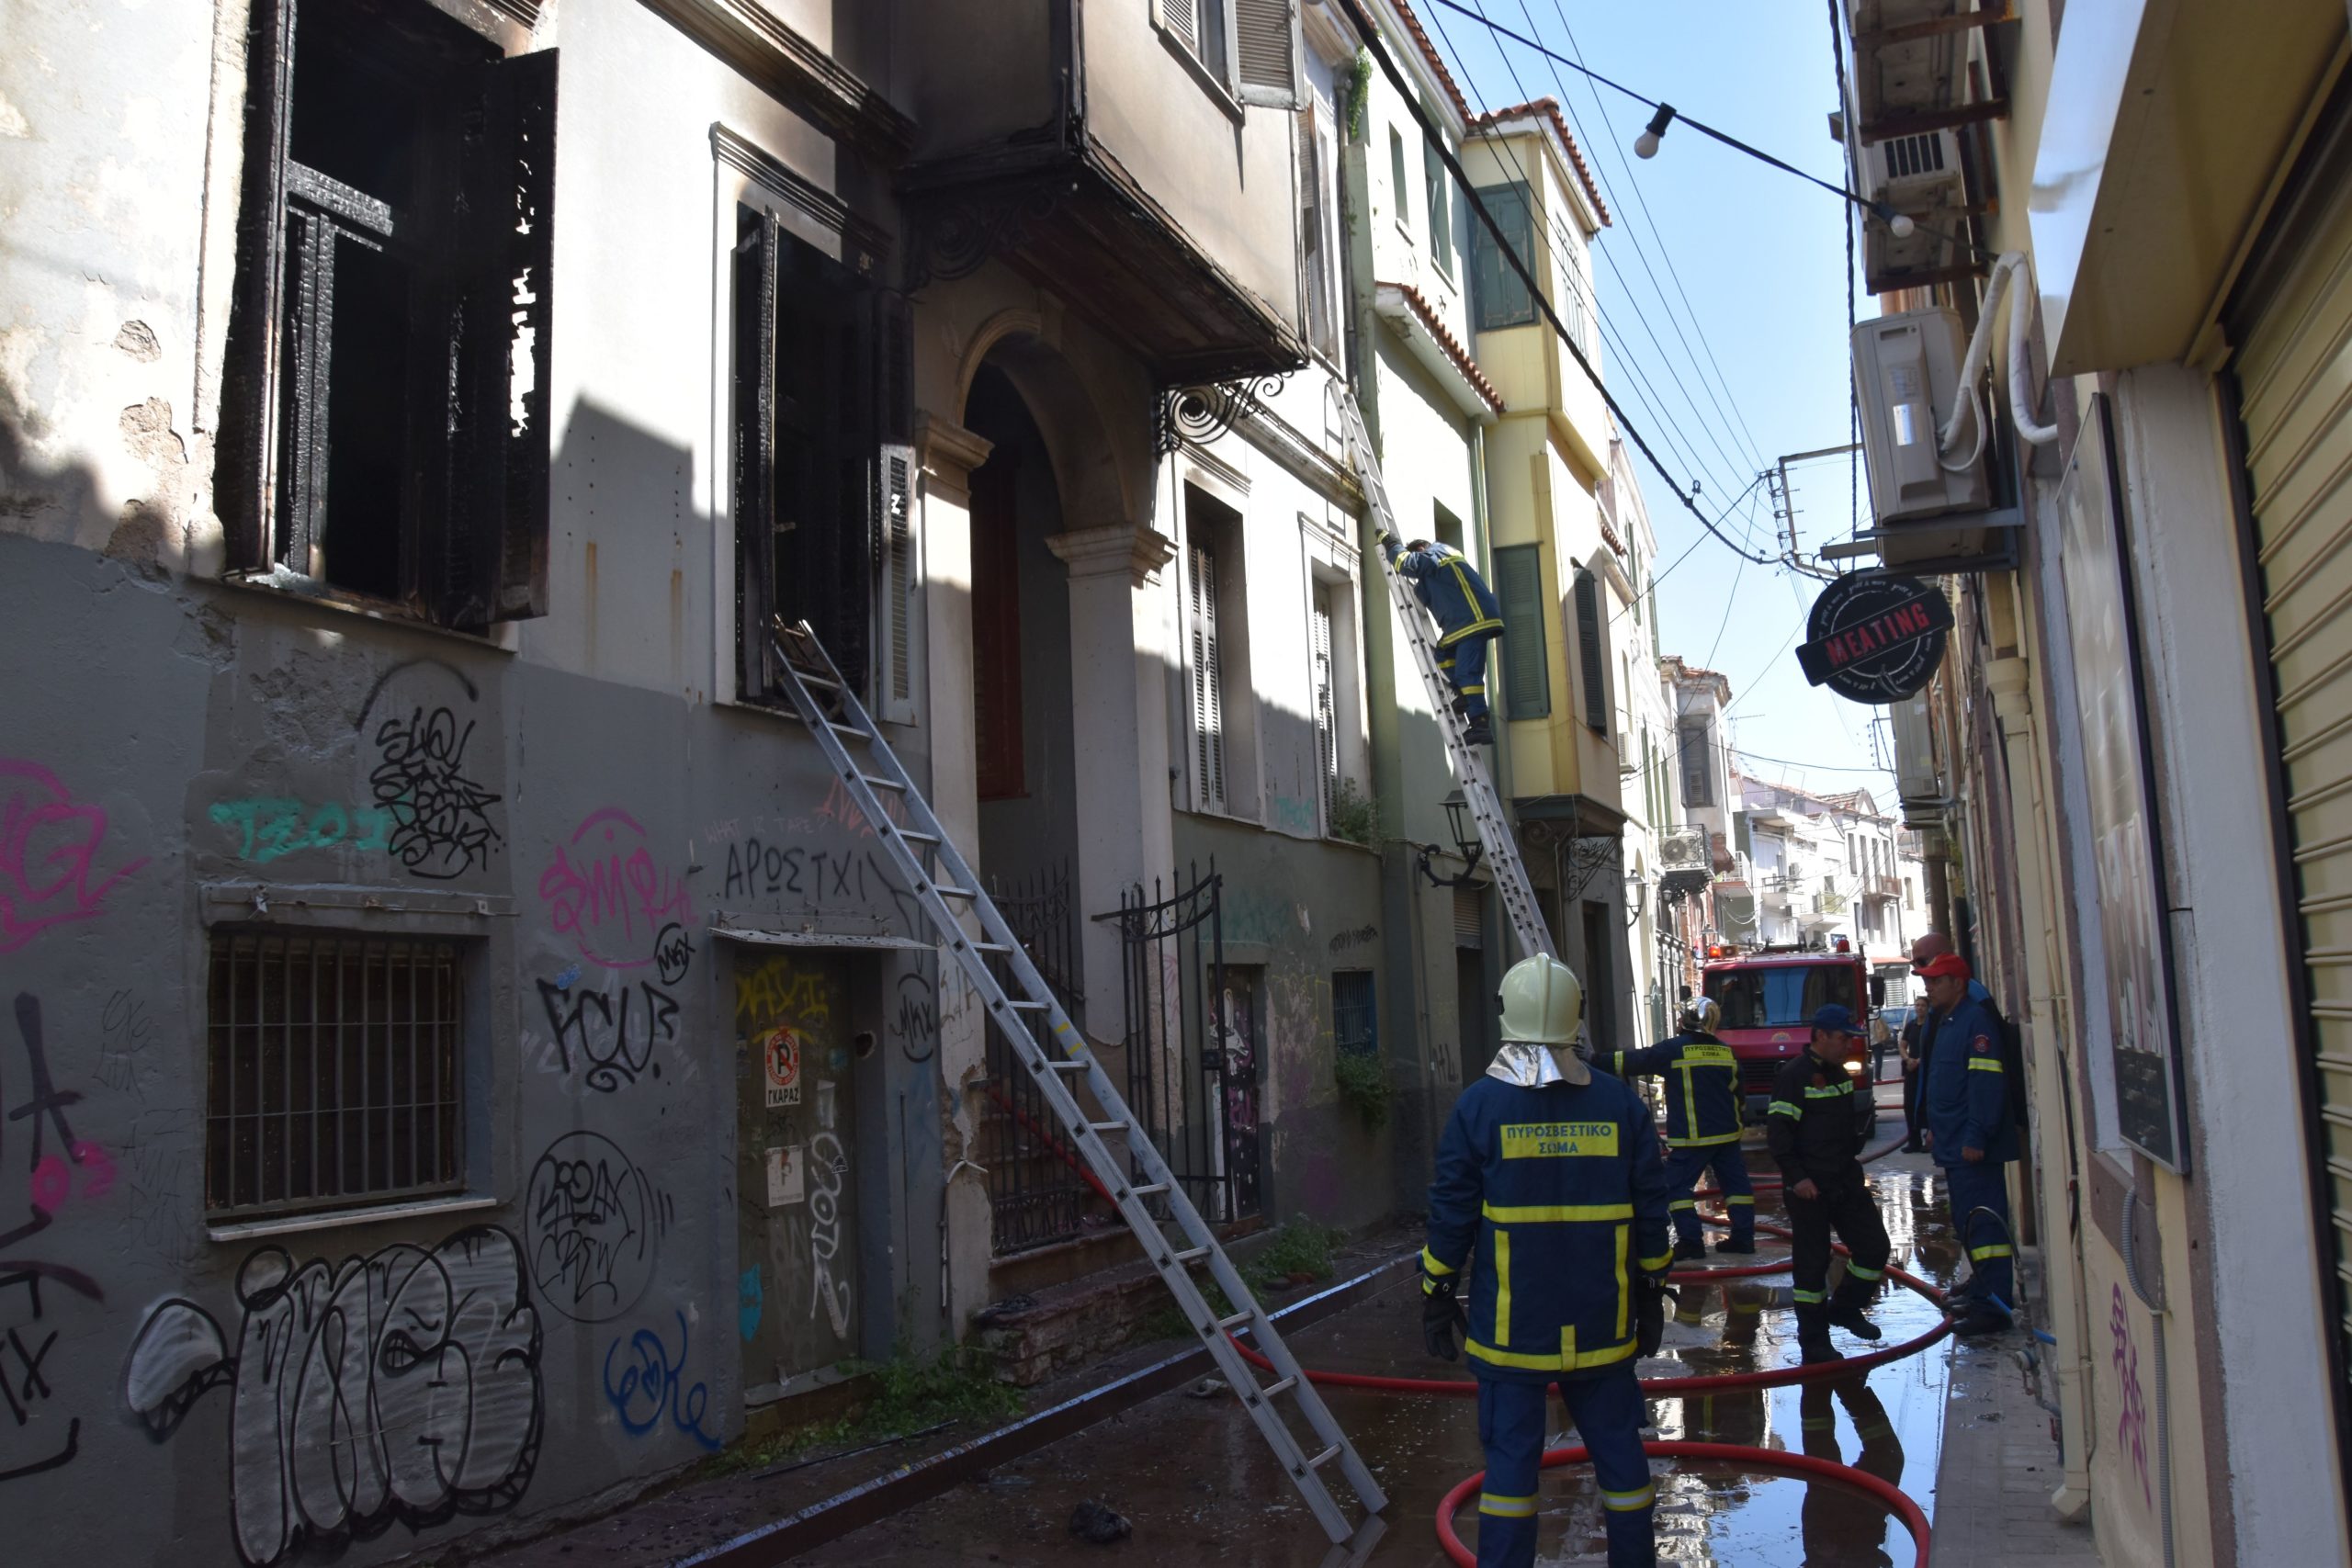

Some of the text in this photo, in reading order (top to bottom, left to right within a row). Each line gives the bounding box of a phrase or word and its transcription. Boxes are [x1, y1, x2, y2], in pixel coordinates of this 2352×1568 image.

[1825, 602, 1930, 669] MEATING
[768, 1087, 798, 1105] ΓΚΑΡΑΖ
[1507, 1124, 1612, 1139] ΠΥΡΟΣΒΕΣΤΙΚΟ
[1539, 1141, 1578, 1154] ΣΩΜΑ
